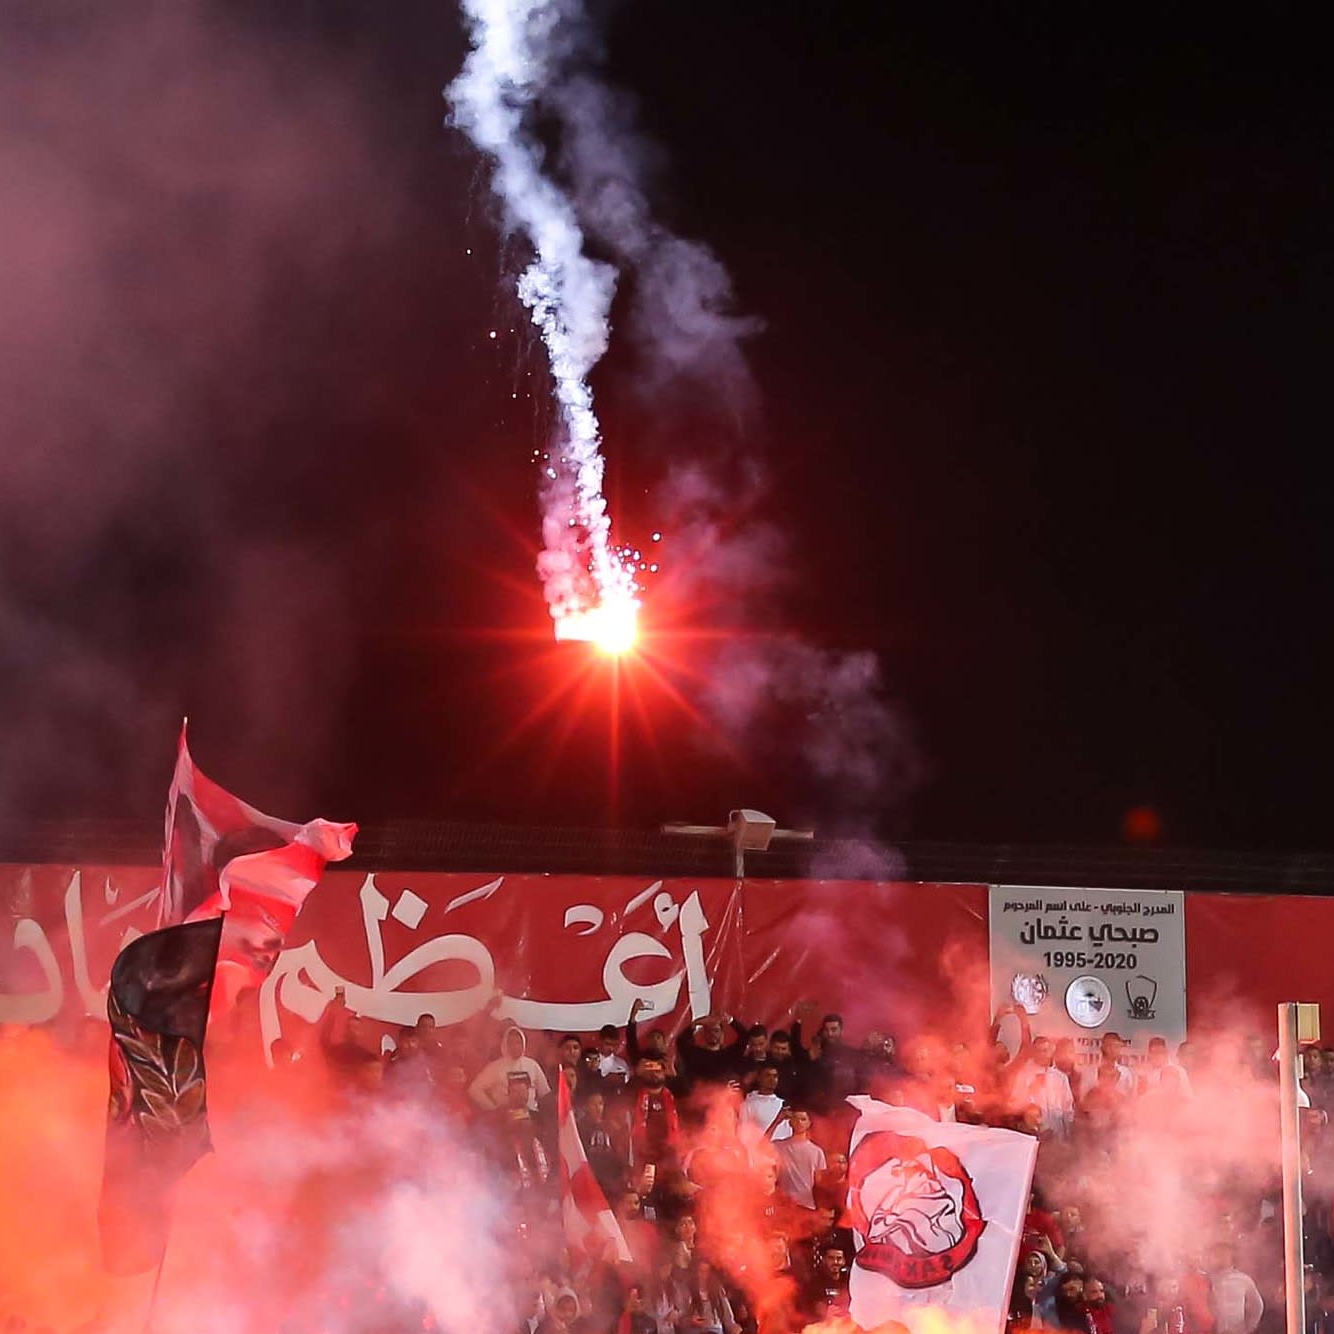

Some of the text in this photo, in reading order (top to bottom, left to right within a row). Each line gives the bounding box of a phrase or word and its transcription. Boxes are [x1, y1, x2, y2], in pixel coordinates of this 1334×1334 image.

[1019, 915, 1159, 948] صبحي عثمان
[1043, 951, 1138, 970] 1995-2020
